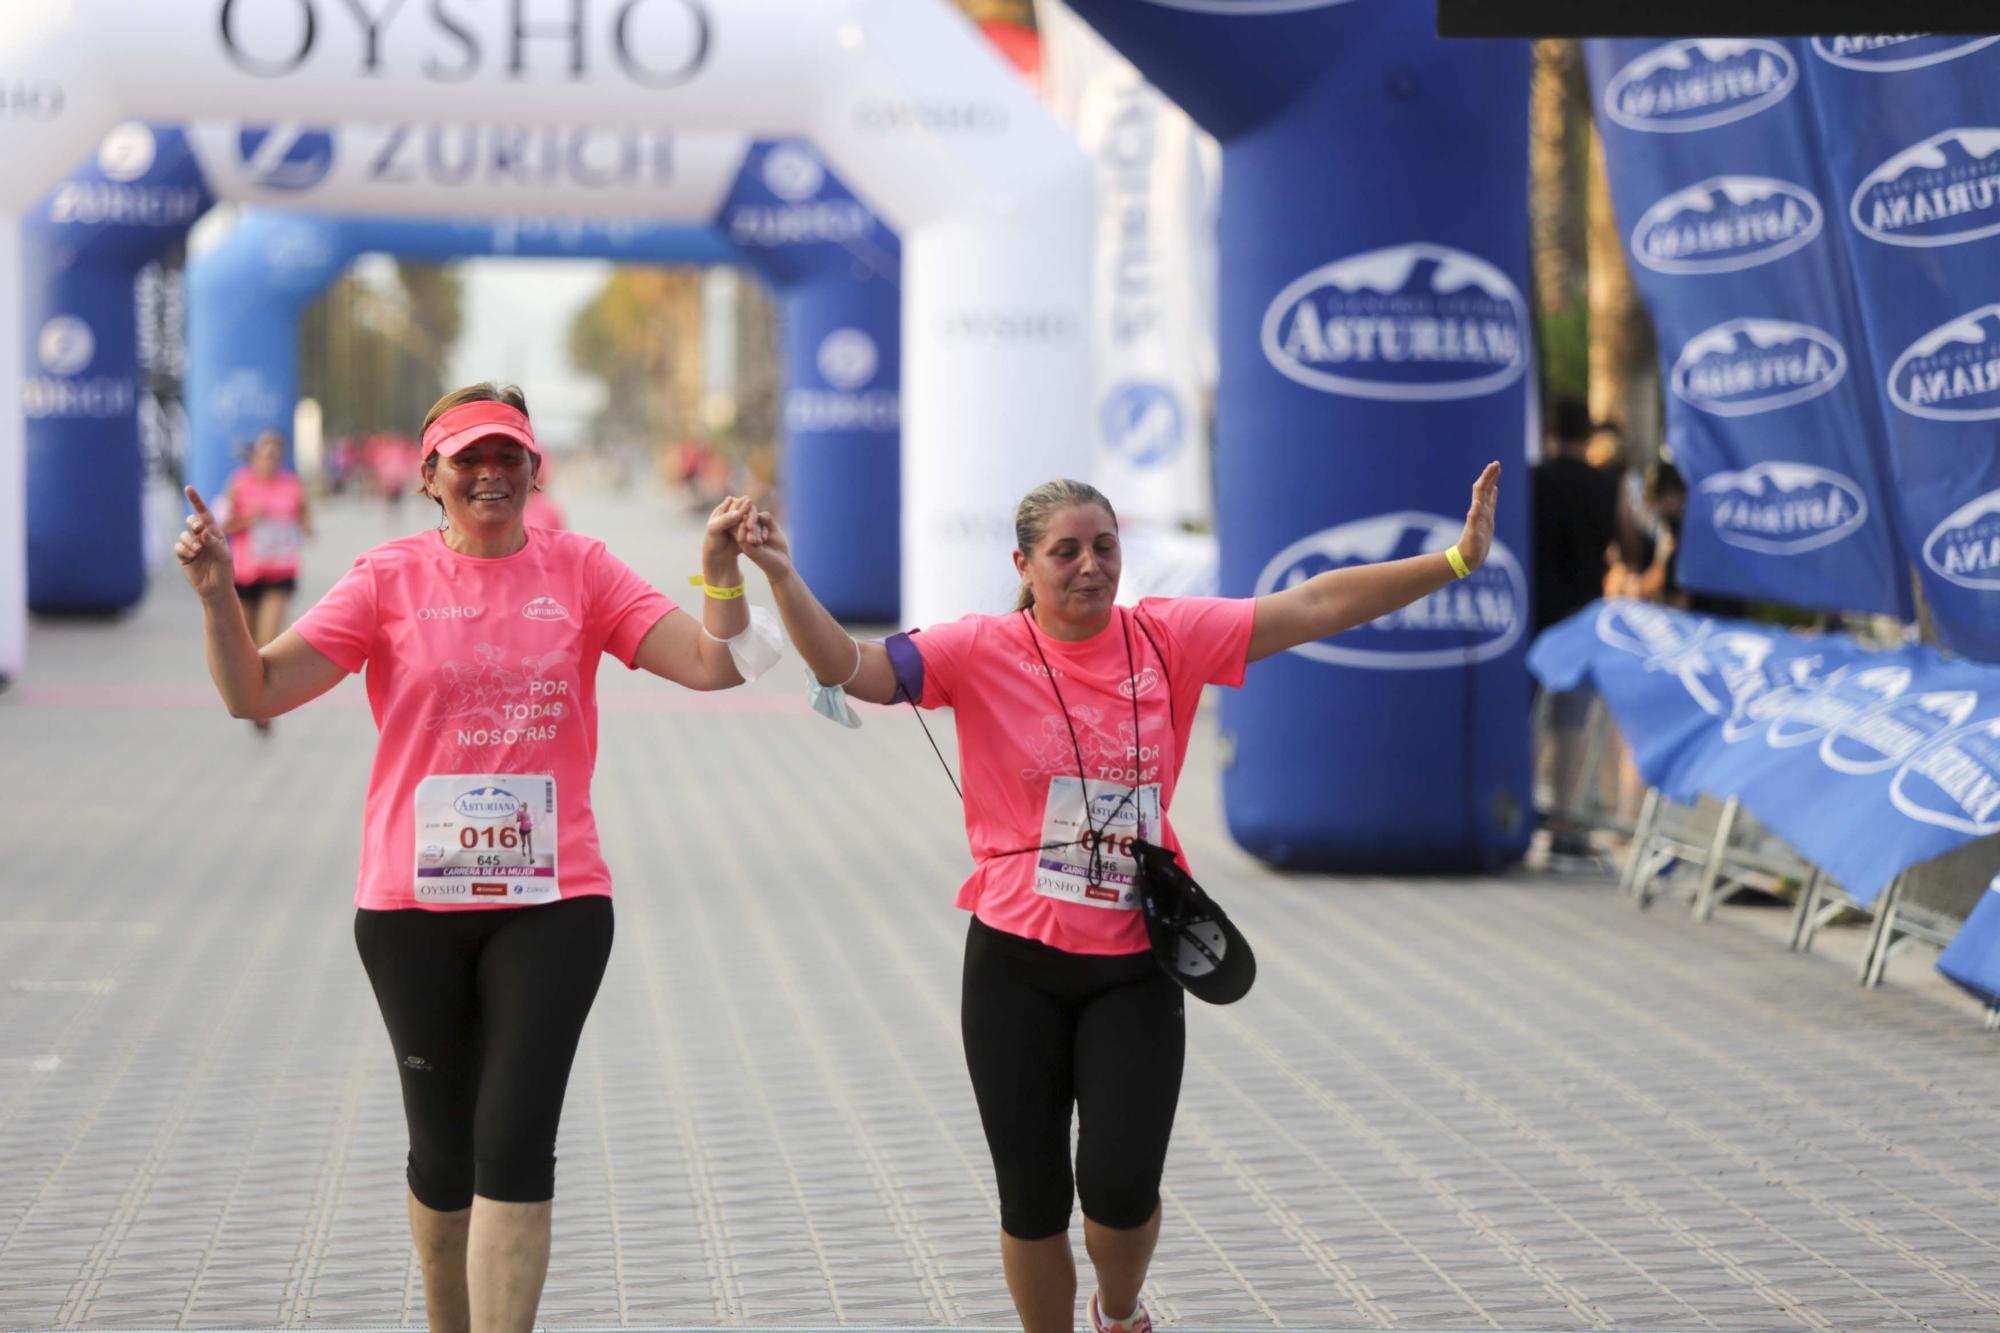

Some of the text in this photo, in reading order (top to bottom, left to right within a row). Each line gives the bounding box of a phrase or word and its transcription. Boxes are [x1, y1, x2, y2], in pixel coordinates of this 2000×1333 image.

[218, 0, 713, 90] OYSHO
[417, 606, 478, 621] OYSHO
[529, 680, 568, 696] POR
[502, 701, 564, 721] TODAS
[457, 724, 557, 746] NOSOTRAS
[1126, 744, 1160, 762] POR
[459, 799, 516, 812] ASTURIANA
[459, 826, 518, 849] 016
[477, 854, 501, 866] 645
[443, 867, 535, 877] CARRERA DE LA MUJER
[420, 884, 466, 896] OYSHO
